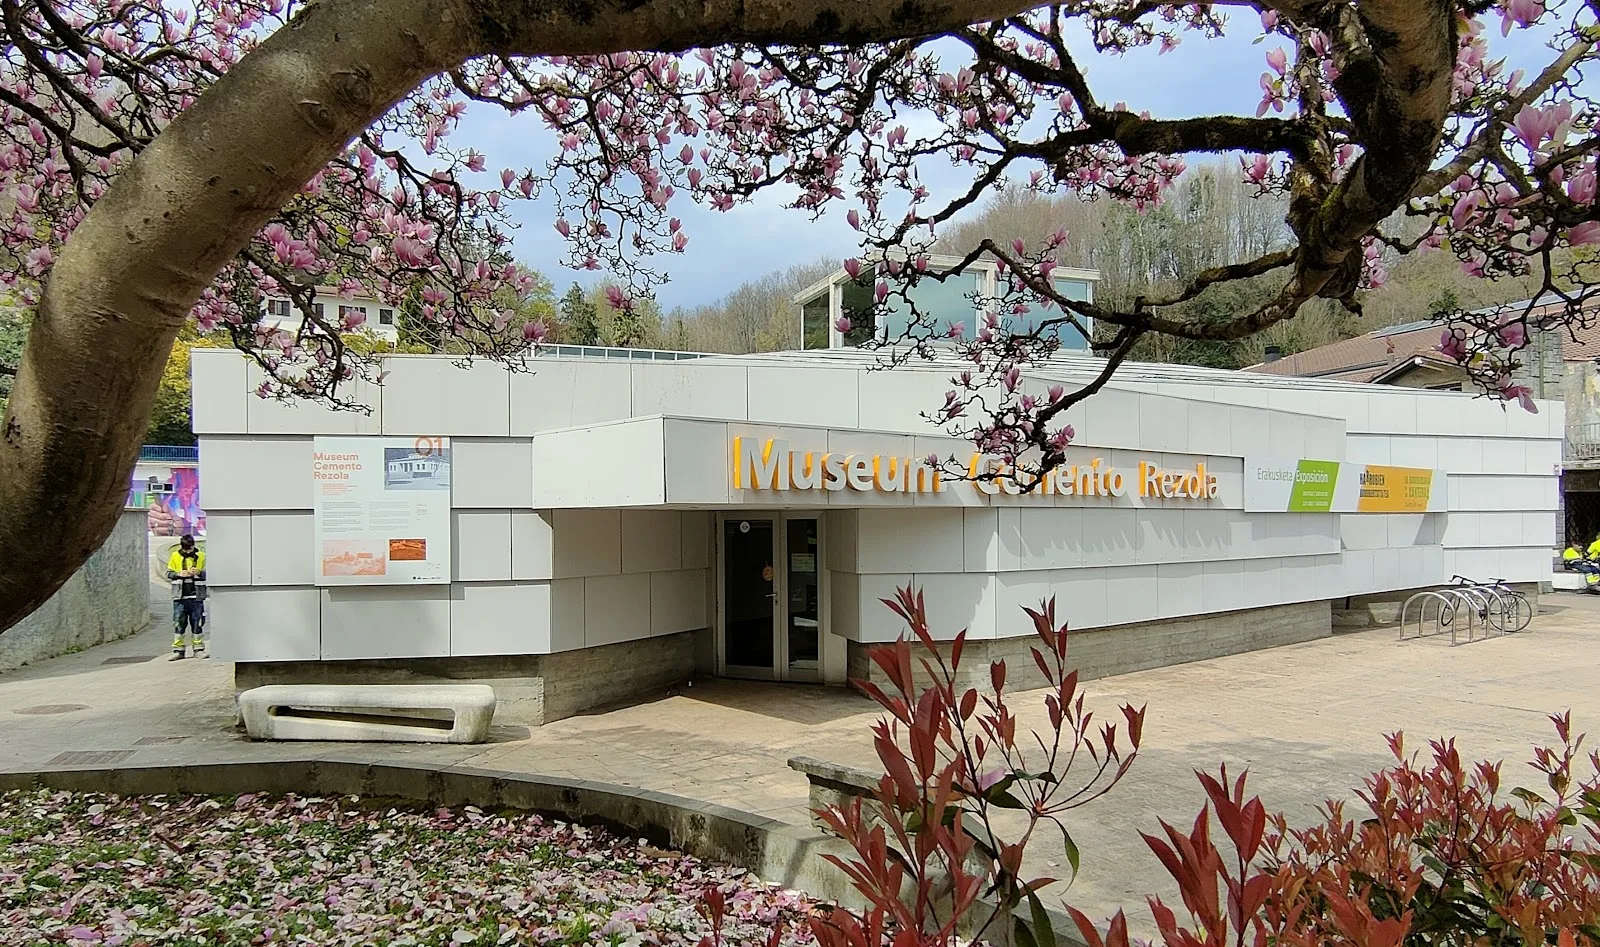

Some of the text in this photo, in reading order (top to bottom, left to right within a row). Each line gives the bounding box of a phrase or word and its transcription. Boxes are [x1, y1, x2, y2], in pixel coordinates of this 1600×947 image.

[313, 452, 359, 461] Museum
[313, 462, 362, 471] Cemento
[734, 436, 948, 494] Museum
[1139, 460, 1221, 500] Rezola
[313, 471, 349, 480] Rezola
[1257, 467, 1329, 485] Erakusketa Exposición
